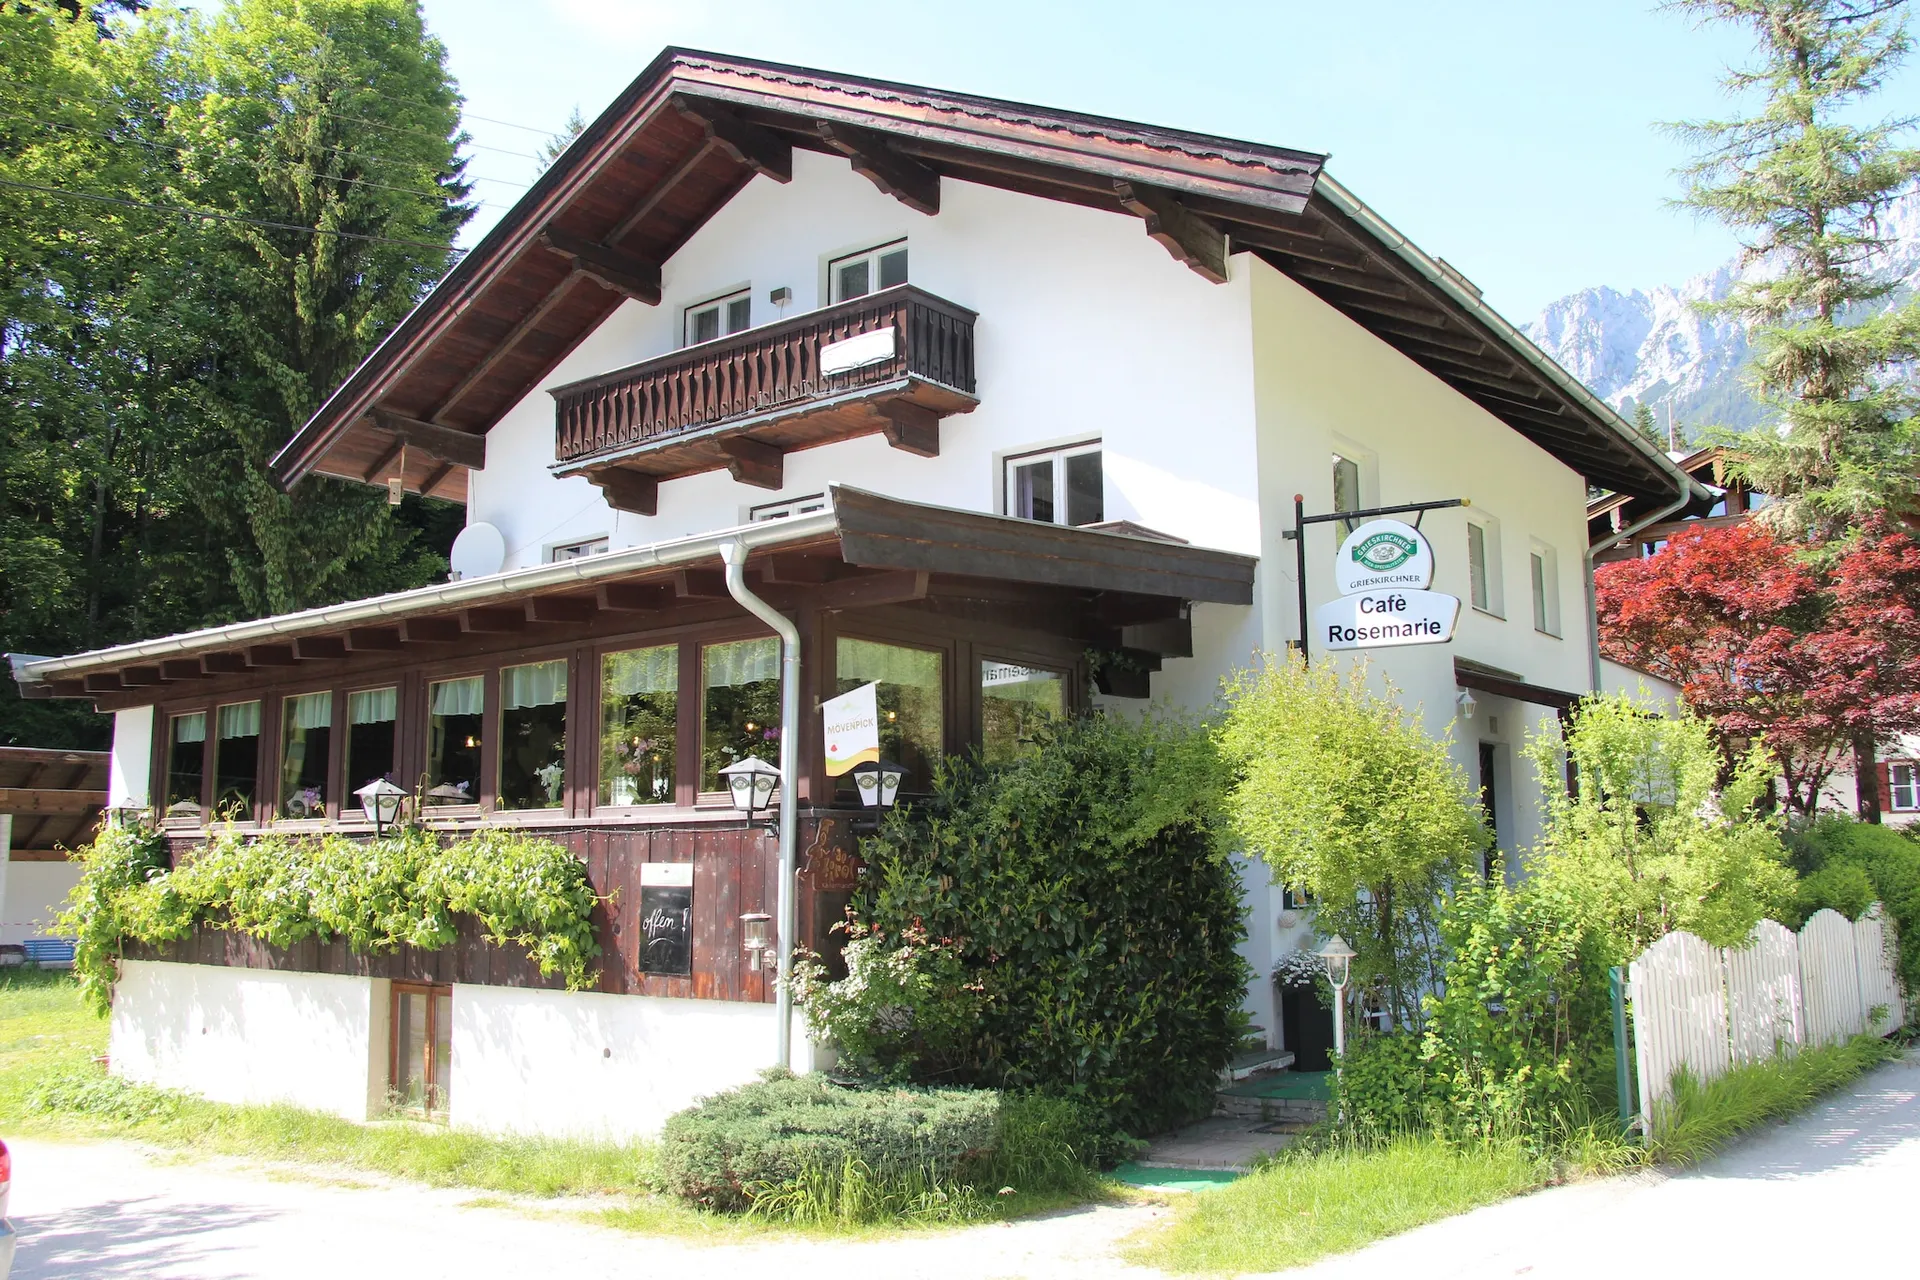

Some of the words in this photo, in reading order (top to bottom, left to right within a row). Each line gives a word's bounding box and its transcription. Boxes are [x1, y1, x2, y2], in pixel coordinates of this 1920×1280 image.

[1357, 534, 1411, 556] GRIESKIRCHNER
[1350, 575, 1420, 589] GRIESKIRCHNER
[1329, 618, 1441, 642] Rosemarie
[827, 718, 874, 735] MÖVENPICK
[643, 908, 678, 938] offen
